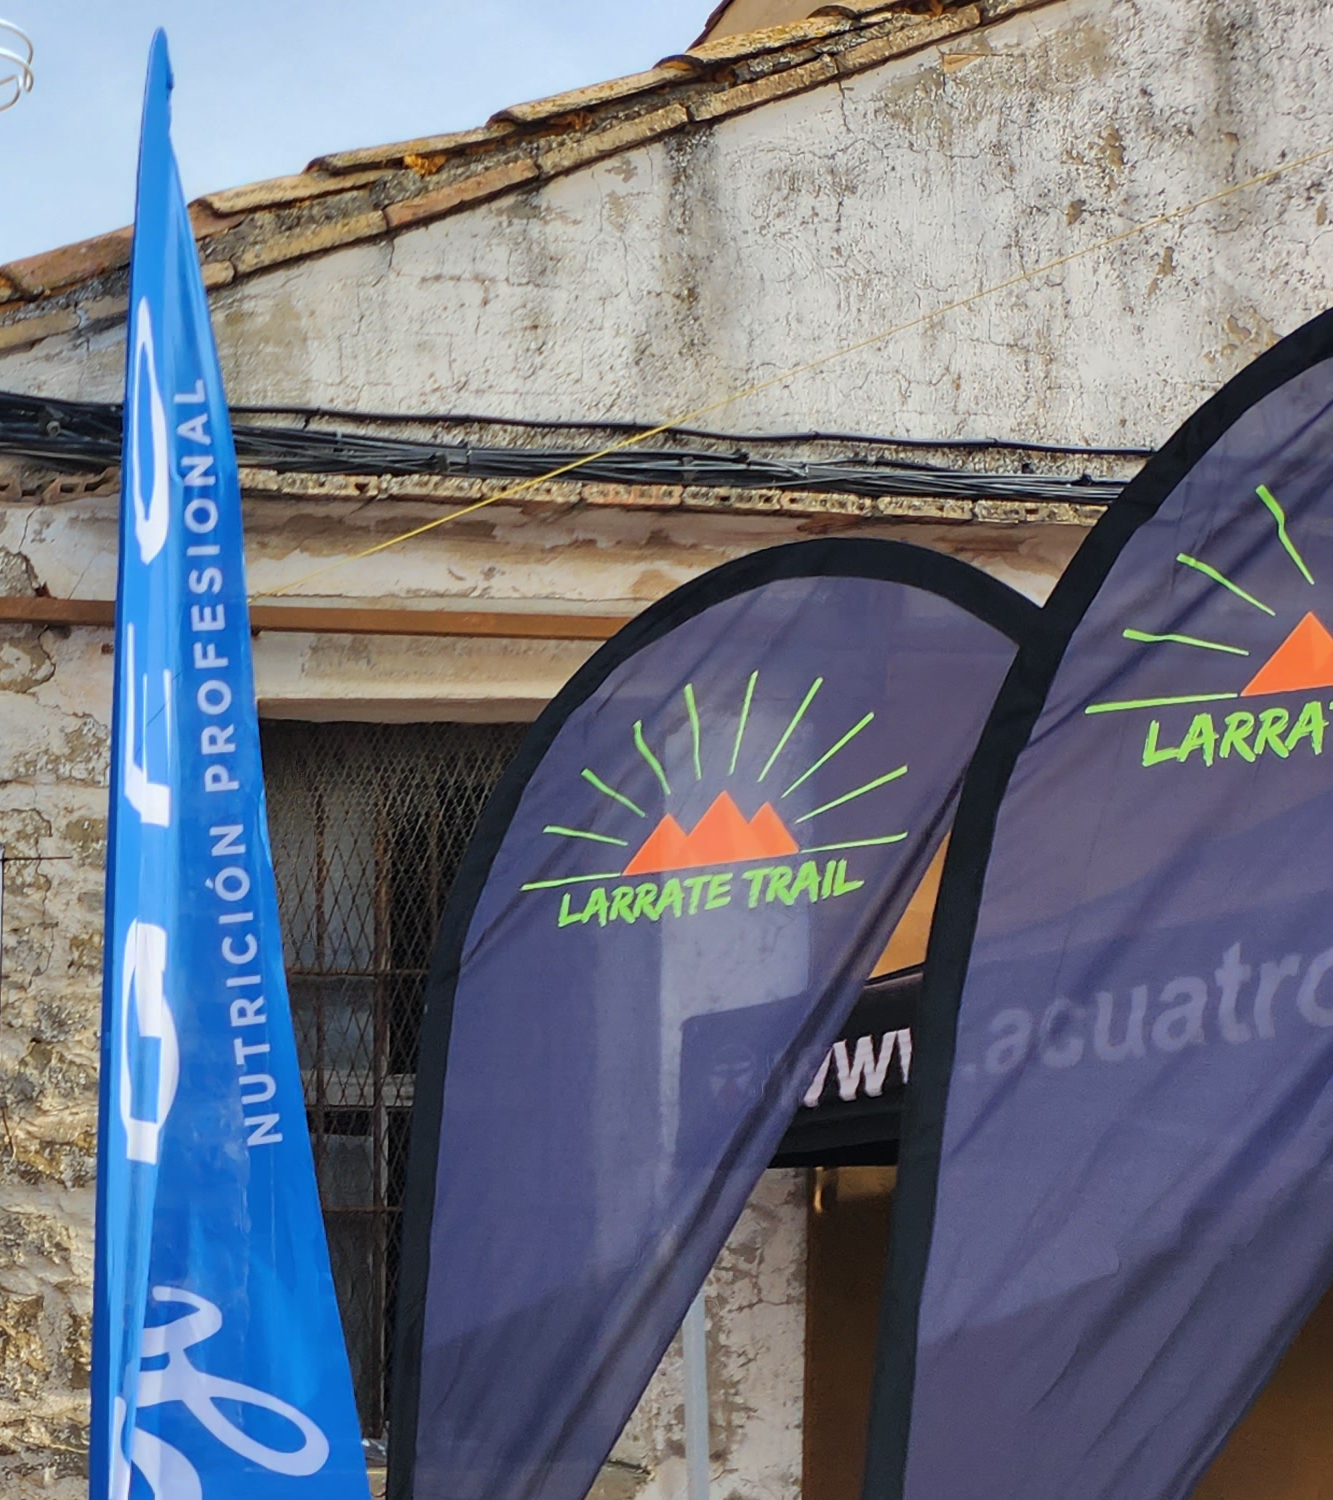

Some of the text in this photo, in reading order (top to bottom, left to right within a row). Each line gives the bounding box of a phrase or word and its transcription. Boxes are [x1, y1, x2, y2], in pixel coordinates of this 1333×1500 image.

[174, 378, 241, 794] PROFESIONAL
[1142, 701, 1333, 767] LARRA
[212, 823, 282, 1147] NUTRICIÓN
[557, 858, 864, 928] LARRATE TRAIL
